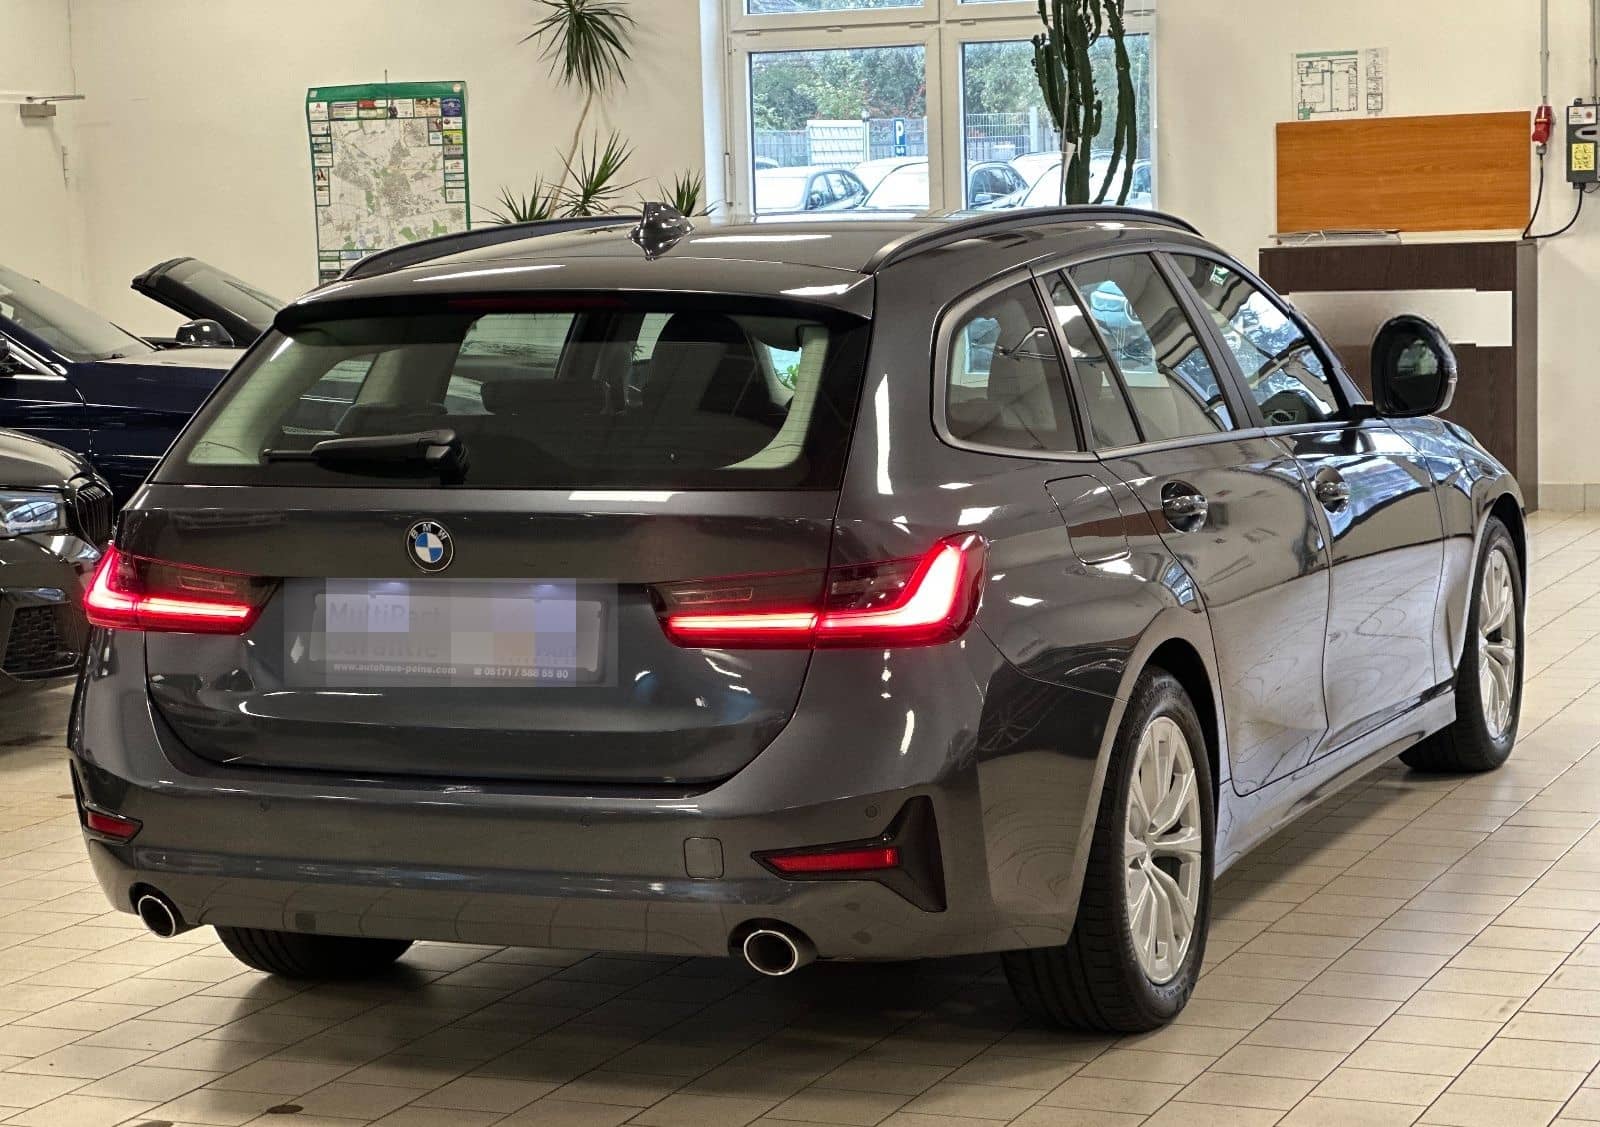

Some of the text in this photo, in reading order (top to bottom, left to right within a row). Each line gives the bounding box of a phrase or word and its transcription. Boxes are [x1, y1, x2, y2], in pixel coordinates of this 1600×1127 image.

[895, 120, 905, 145] P
[410, 523, 447, 540] BMW
[333, 663, 457, 675] www.autohaus-peine.com
